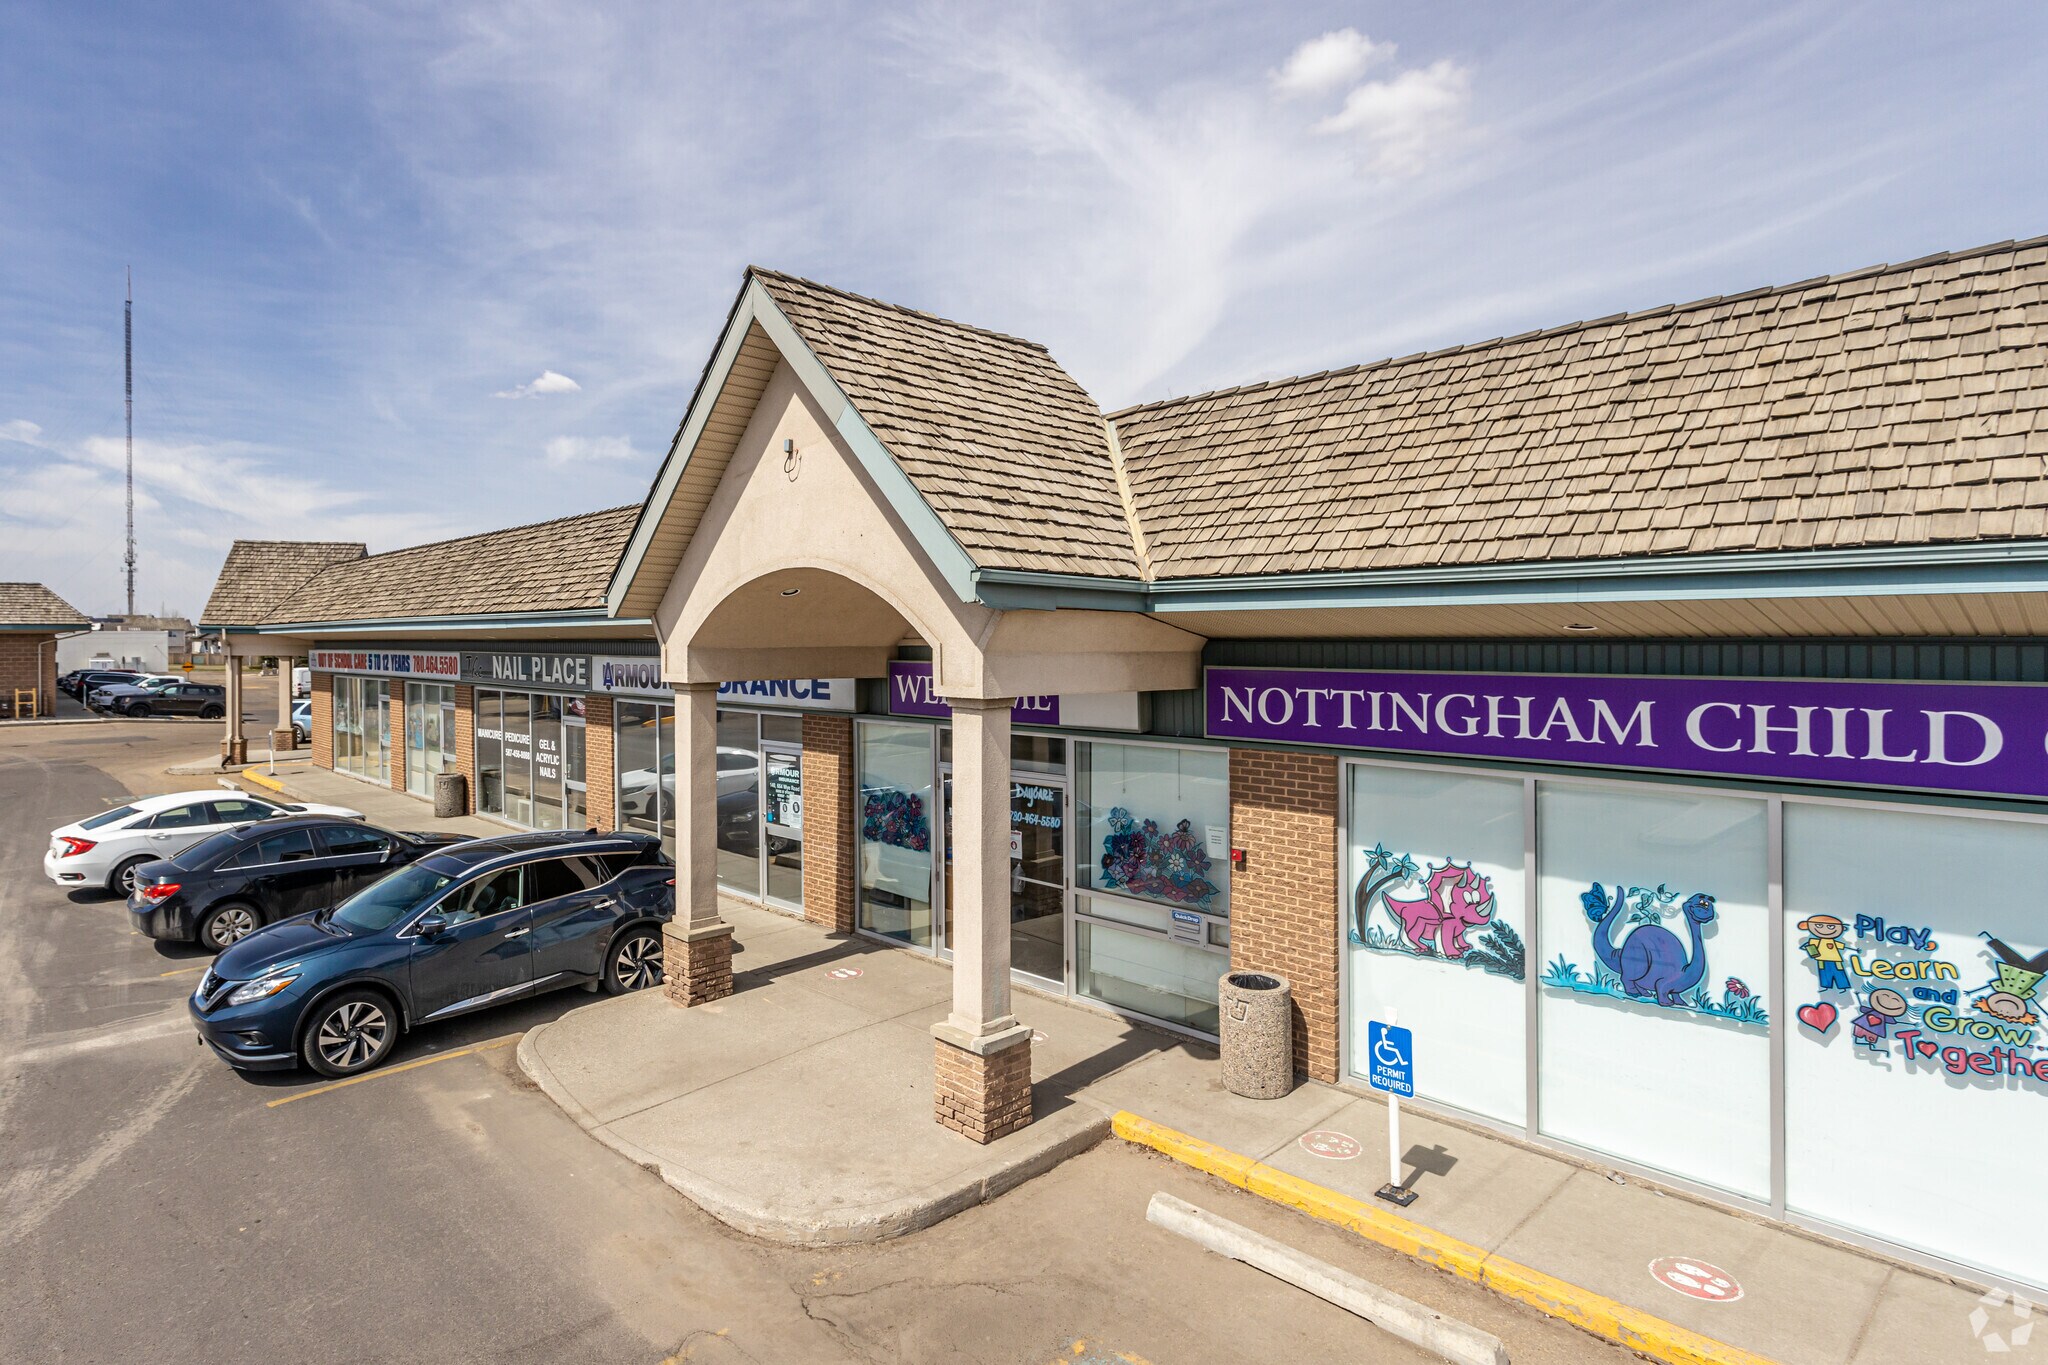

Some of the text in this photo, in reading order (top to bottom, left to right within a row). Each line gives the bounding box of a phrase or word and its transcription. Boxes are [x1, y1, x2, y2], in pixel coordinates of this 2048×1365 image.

[354, 653, 367, 670] CARE
[368, 653, 373, 670] 5
[374, 654, 381, 670] TO
[382, 654, 389, 671] 12
[390, 654, 410, 672] YEARS
[412, 655, 458, 675] 780.464.5580
[492, 655, 527, 681] NAIL
[531, 656, 586, 685] PLACE
[603, 662, 672, 690] ARMOU
[478, 728, 502, 740] MANICURE
[1220, 685, 2004, 767] NOTTINGHAM CHILD
[505, 732, 530, 745] PEDICURE
[539, 739, 556, 751] GEL &
[536, 752, 560, 765] ACRYLIC
[539, 767, 556, 779] NAILS
[1854, 913, 1938, 952] Play,
[1850, 955, 1960, 981] Learn
[1912, 985, 1958, 1006] and
[1377, 1065, 1405, 1080] PERMIT
[1372, 1074, 1412, 1093] REQUIRED
